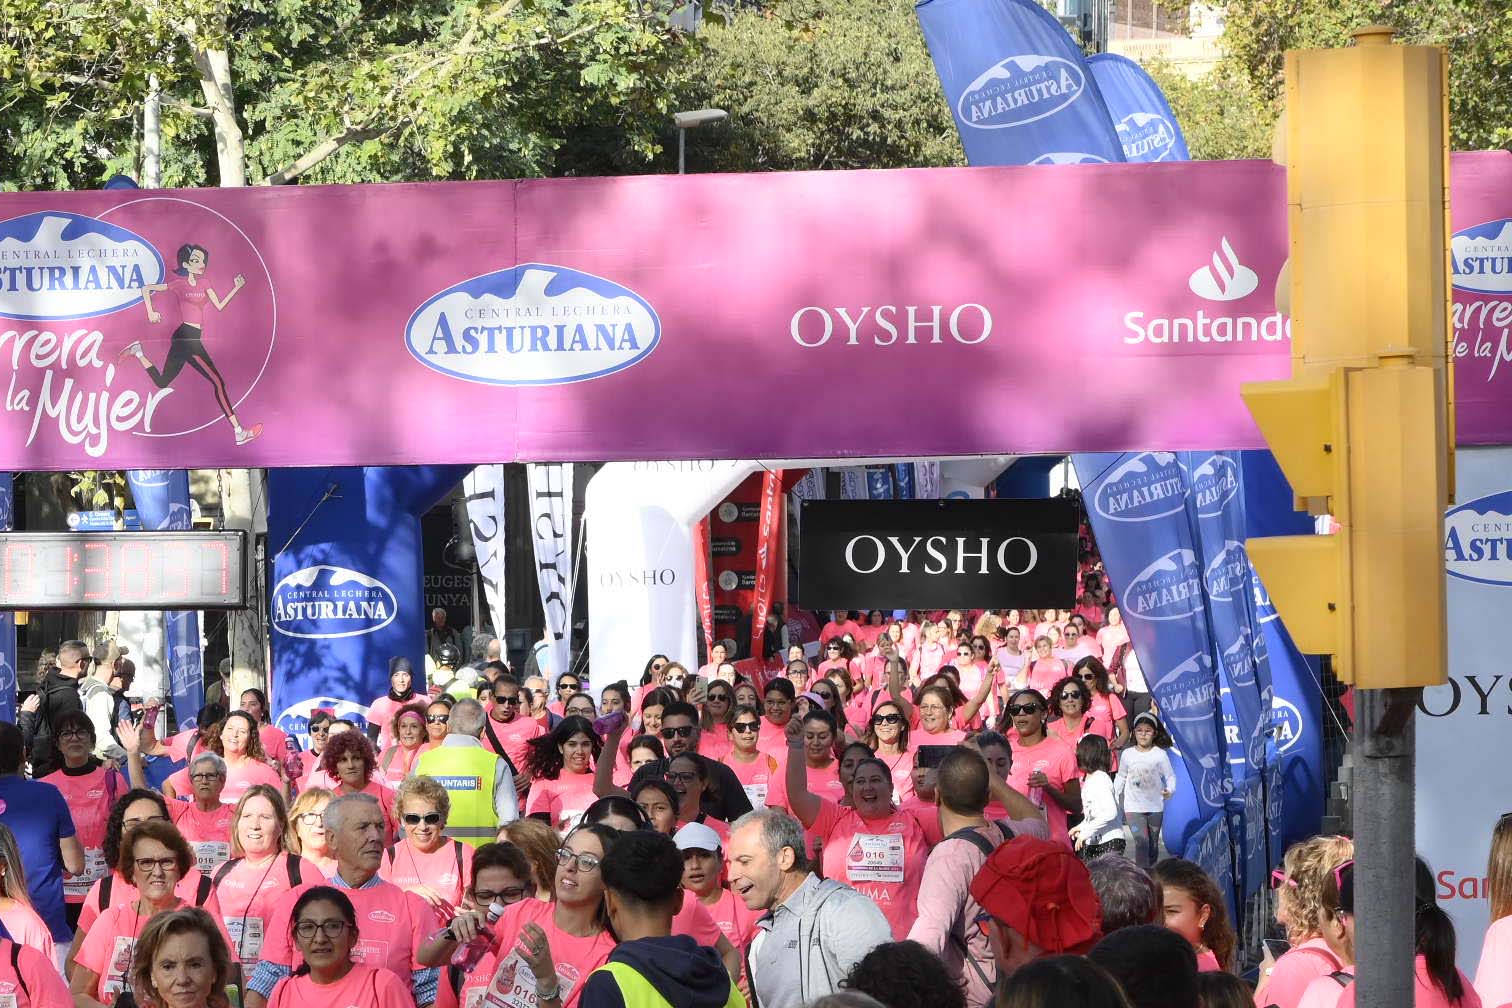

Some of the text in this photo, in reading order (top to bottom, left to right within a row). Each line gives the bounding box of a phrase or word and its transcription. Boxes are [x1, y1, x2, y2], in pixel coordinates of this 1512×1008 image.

[66, 248, 140, 259] LECHERA
[464, 304, 633, 319] CENTRAL LECHERA
[790, 303, 993, 347] OYSHO
[424, 311, 641, 356] ASTURIANA
[1123, 310, 1292, 344] Santand
[6, 373, 30, 411] la
[25, 364, 175, 458] Mujer
[845, 534, 1039, 576] OYSHO
[274, 594, 388, 622] ASTURIANA
[287, 590, 330, 599] CENTRAL
[441, 779, 476, 787] UNTARIS
[514, 986, 536, 1004] 016
